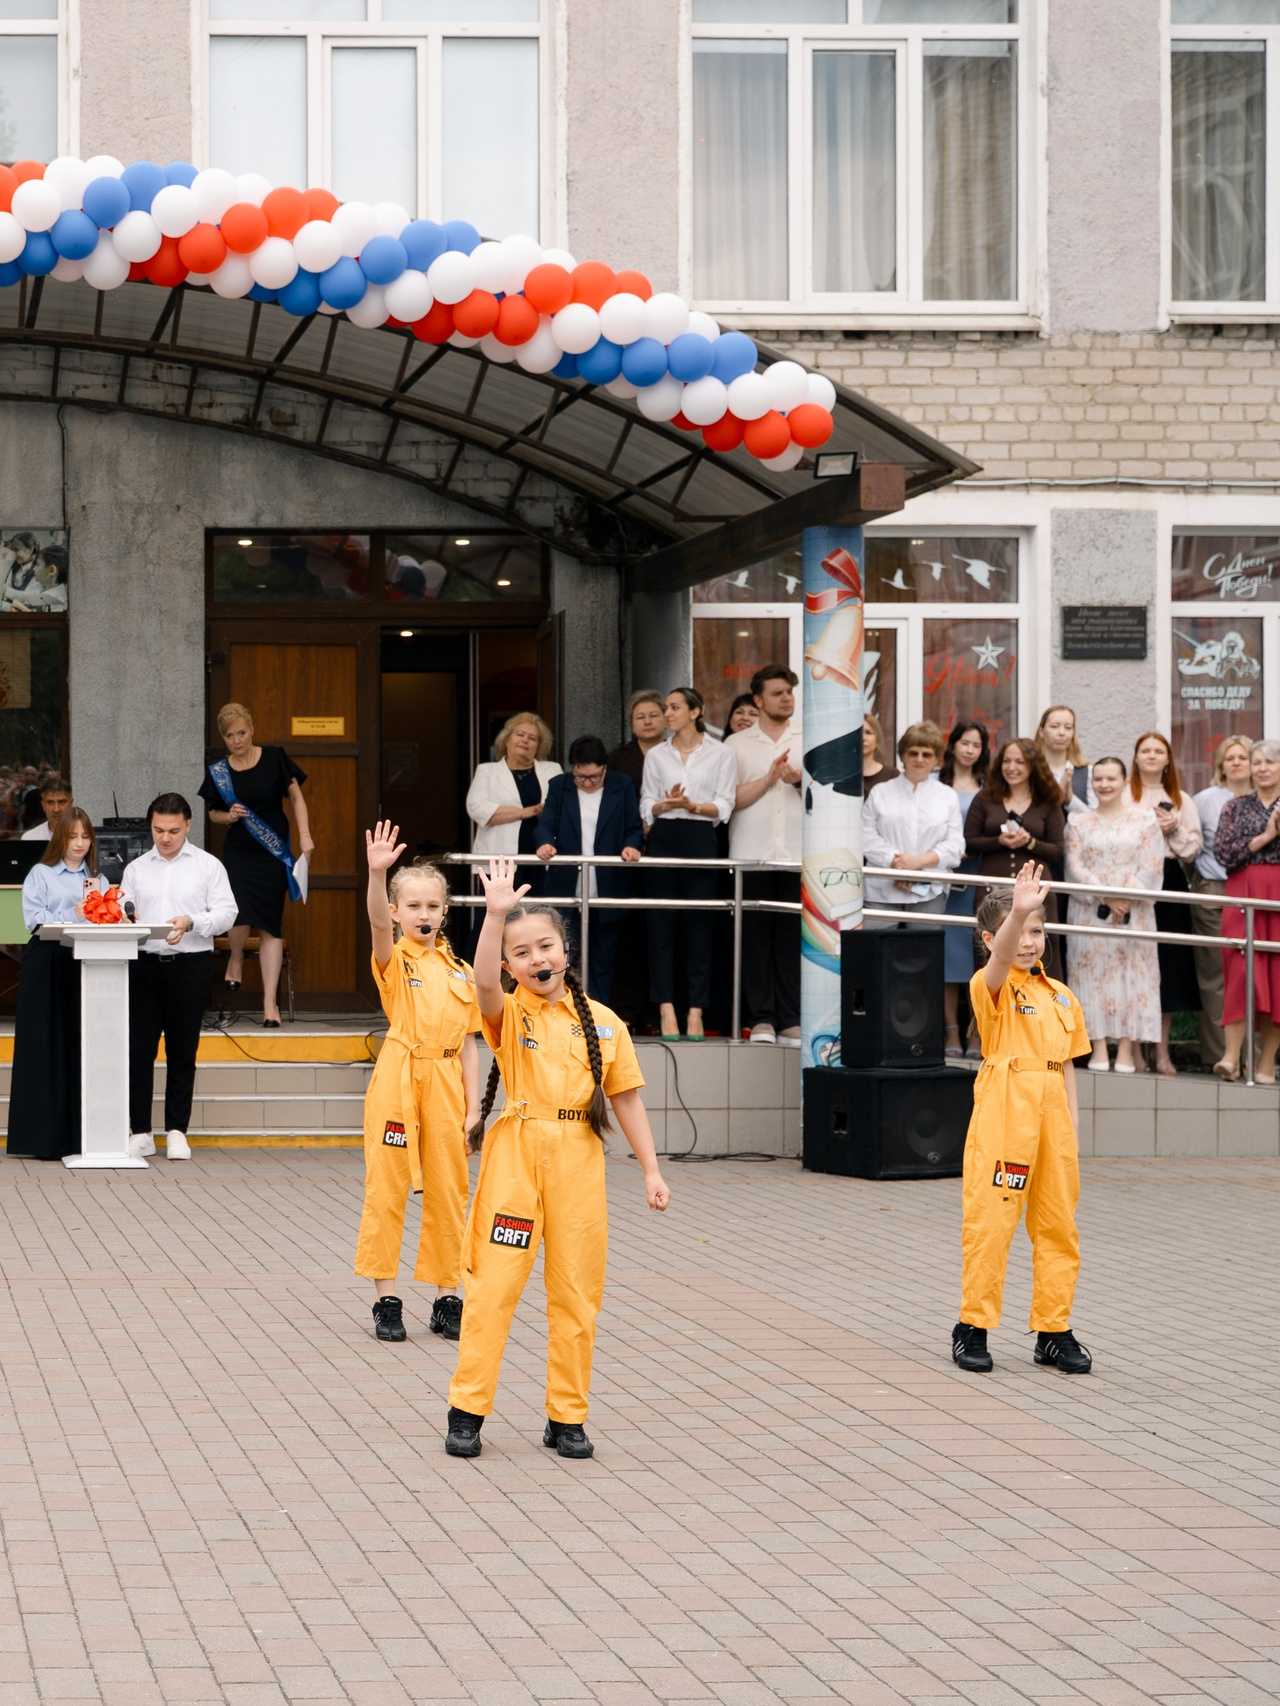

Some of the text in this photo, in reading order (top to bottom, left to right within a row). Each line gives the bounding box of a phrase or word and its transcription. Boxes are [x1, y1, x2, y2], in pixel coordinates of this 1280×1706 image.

[1203, 552, 1226, 580] С
[1215, 562, 1273, 598] Победы!
[924, 652, 951, 693] 9
[1180, 686, 1252, 699] СПАСИБО ДЕДУ
[1187, 699, 1246, 711] ЗА ПОБЕДУ!
[997, 1162, 1029, 1176] FSHION
[495, 1216, 533, 1232] FASHION
[493, 1226, 530, 1246] CRFT
